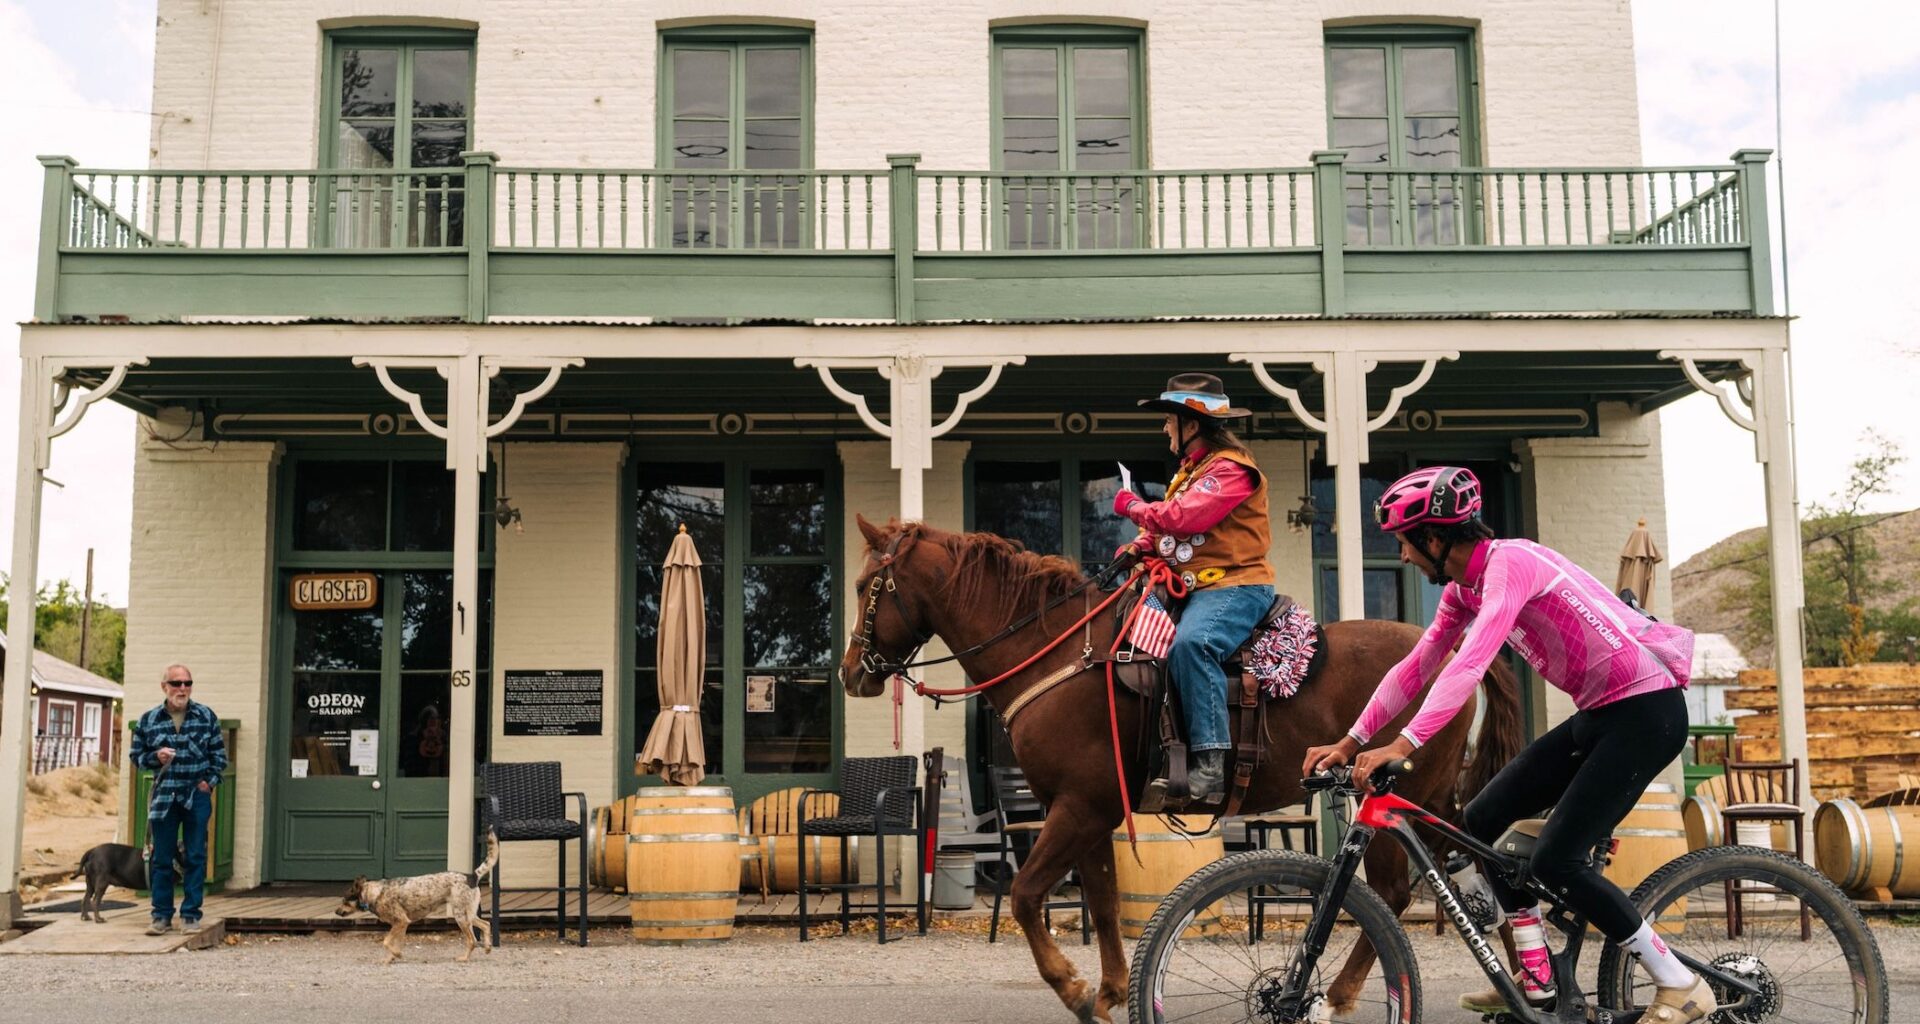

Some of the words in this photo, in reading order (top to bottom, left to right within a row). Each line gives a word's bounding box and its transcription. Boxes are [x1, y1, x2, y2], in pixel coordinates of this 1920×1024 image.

[299, 579, 367, 602] CLOSED
[1560, 589, 1624, 650] cannondale
[452, 670, 471, 688] 65
[307, 693, 366, 708] ODEON
[319, 707, 354, 716] SALOON
[1426, 869, 1502, 975] cannondale
